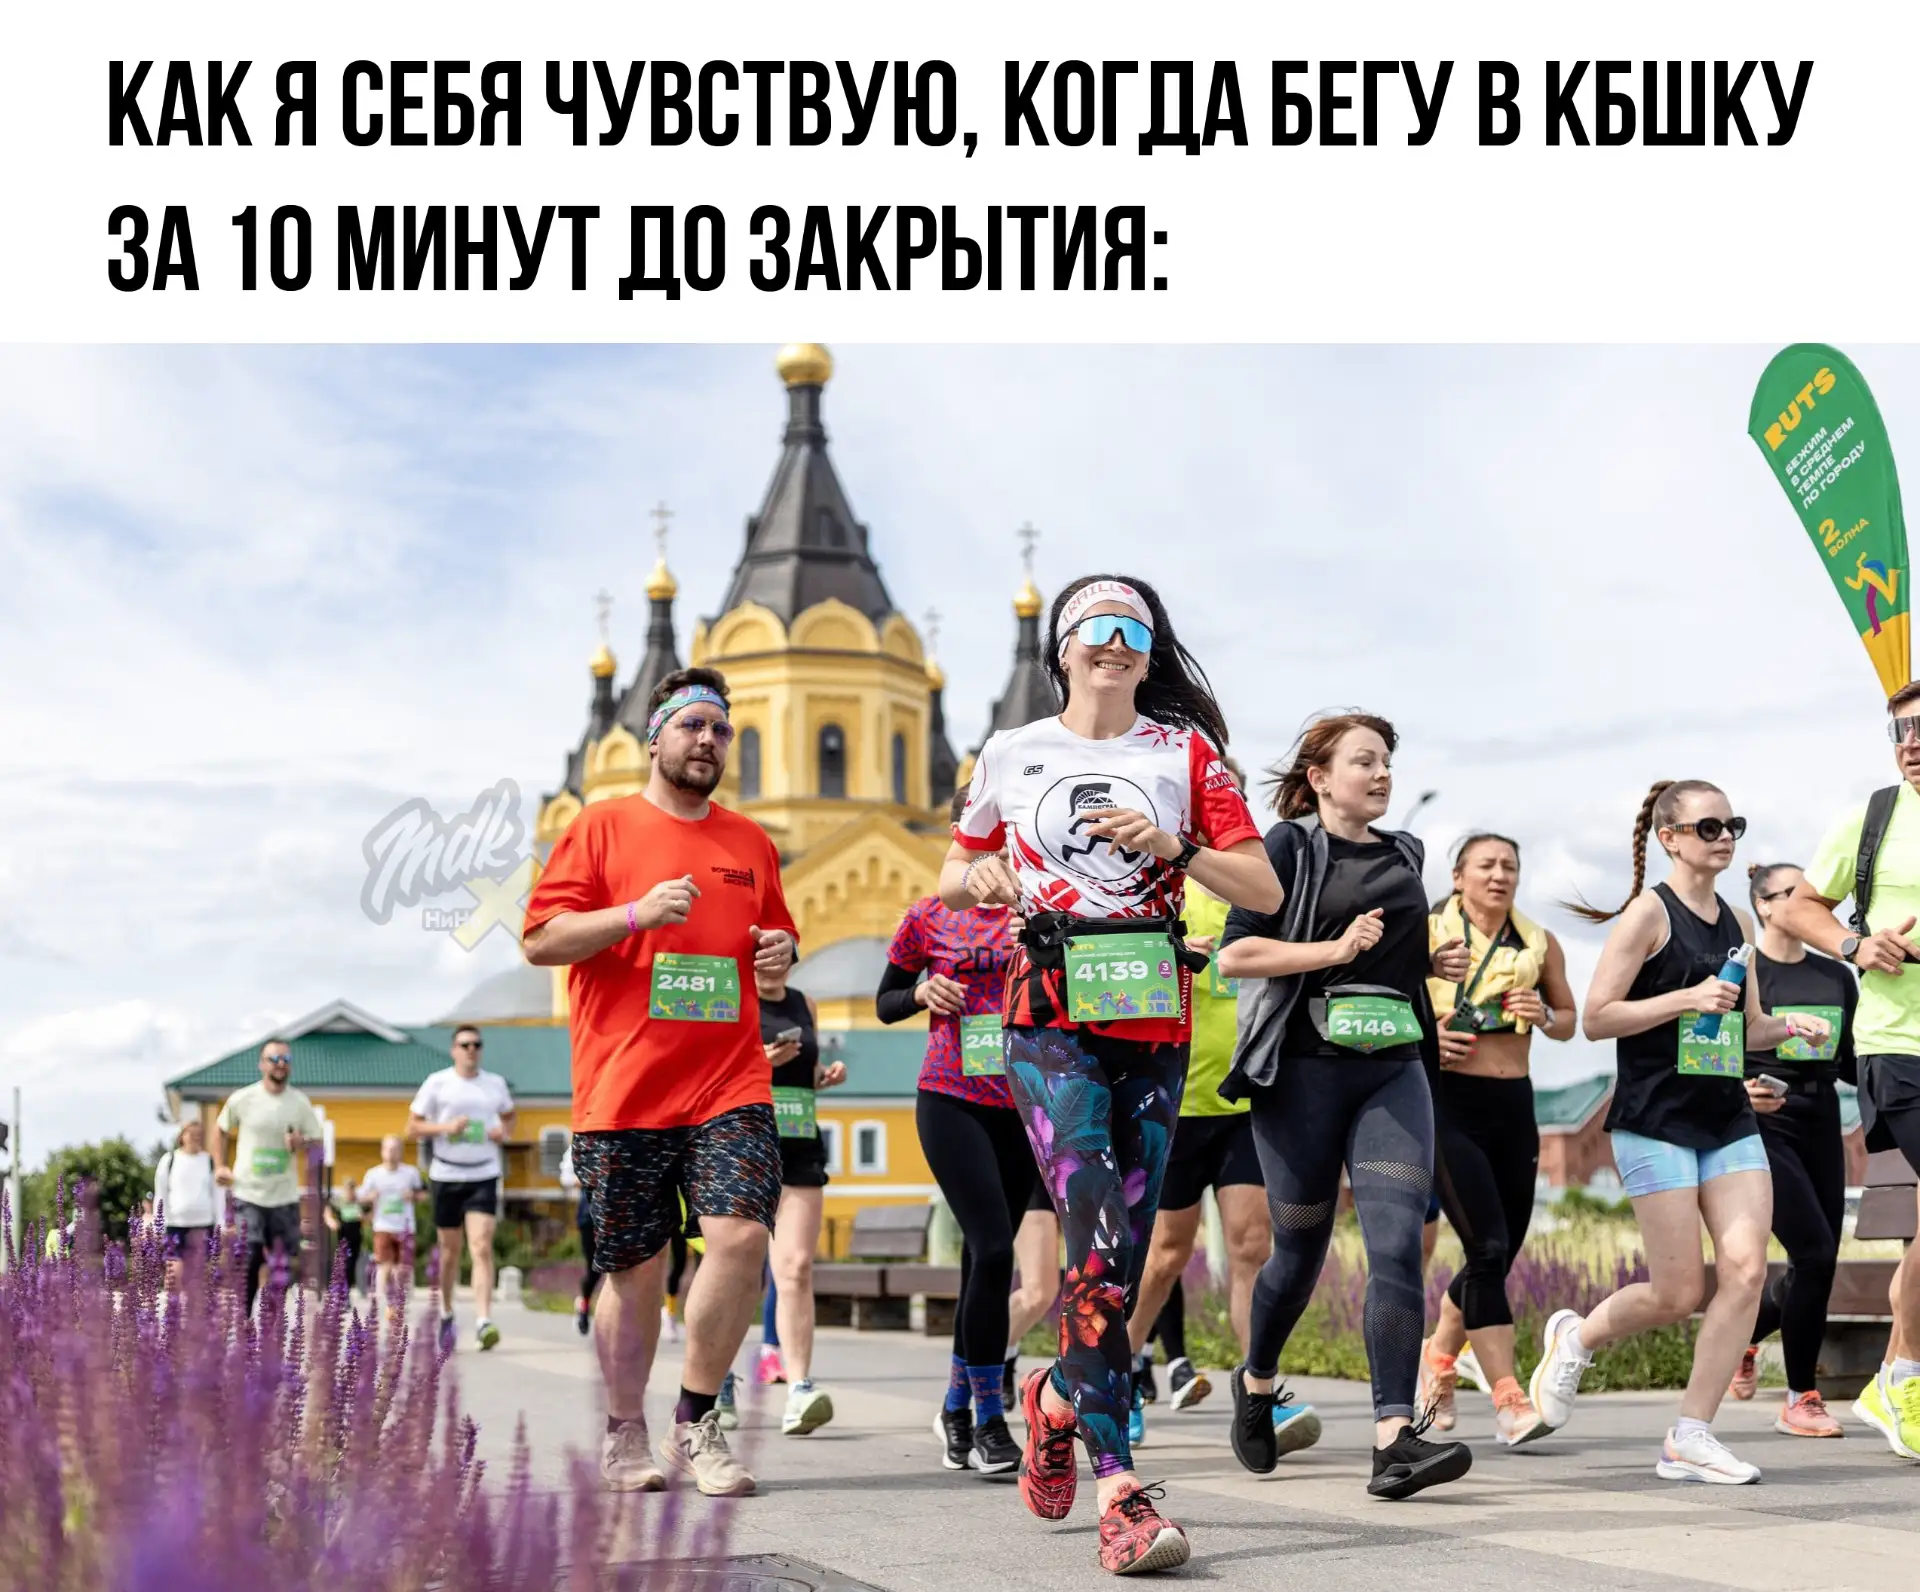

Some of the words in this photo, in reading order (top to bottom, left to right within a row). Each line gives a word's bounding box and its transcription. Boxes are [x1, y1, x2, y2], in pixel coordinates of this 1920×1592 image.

[1764, 367, 1836, 451] RUTS
[1785, 426, 1828, 476] БЕЖИМ
[1790, 474, 1800, 487] В
[1800, 416, 1855, 476] СРЕДНЕМ
[1797, 454, 1836, 496] ТЕМПЕ
[1802, 488, 1820, 510] ПО
[1820, 440, 1865, 491] ГОРОДУ
[1819, 518, 1841, 547] 2
[1828, 518, 1870, 558] ВОЛНА
[1023, 764, 1045, 776] GS
[657, 973, 716, 993] 2481
[1074, 960, 1149, 982] 4139
[1161, 962, 1169, 971] 3
[1335, 1018, 1397, 1036] 2146
